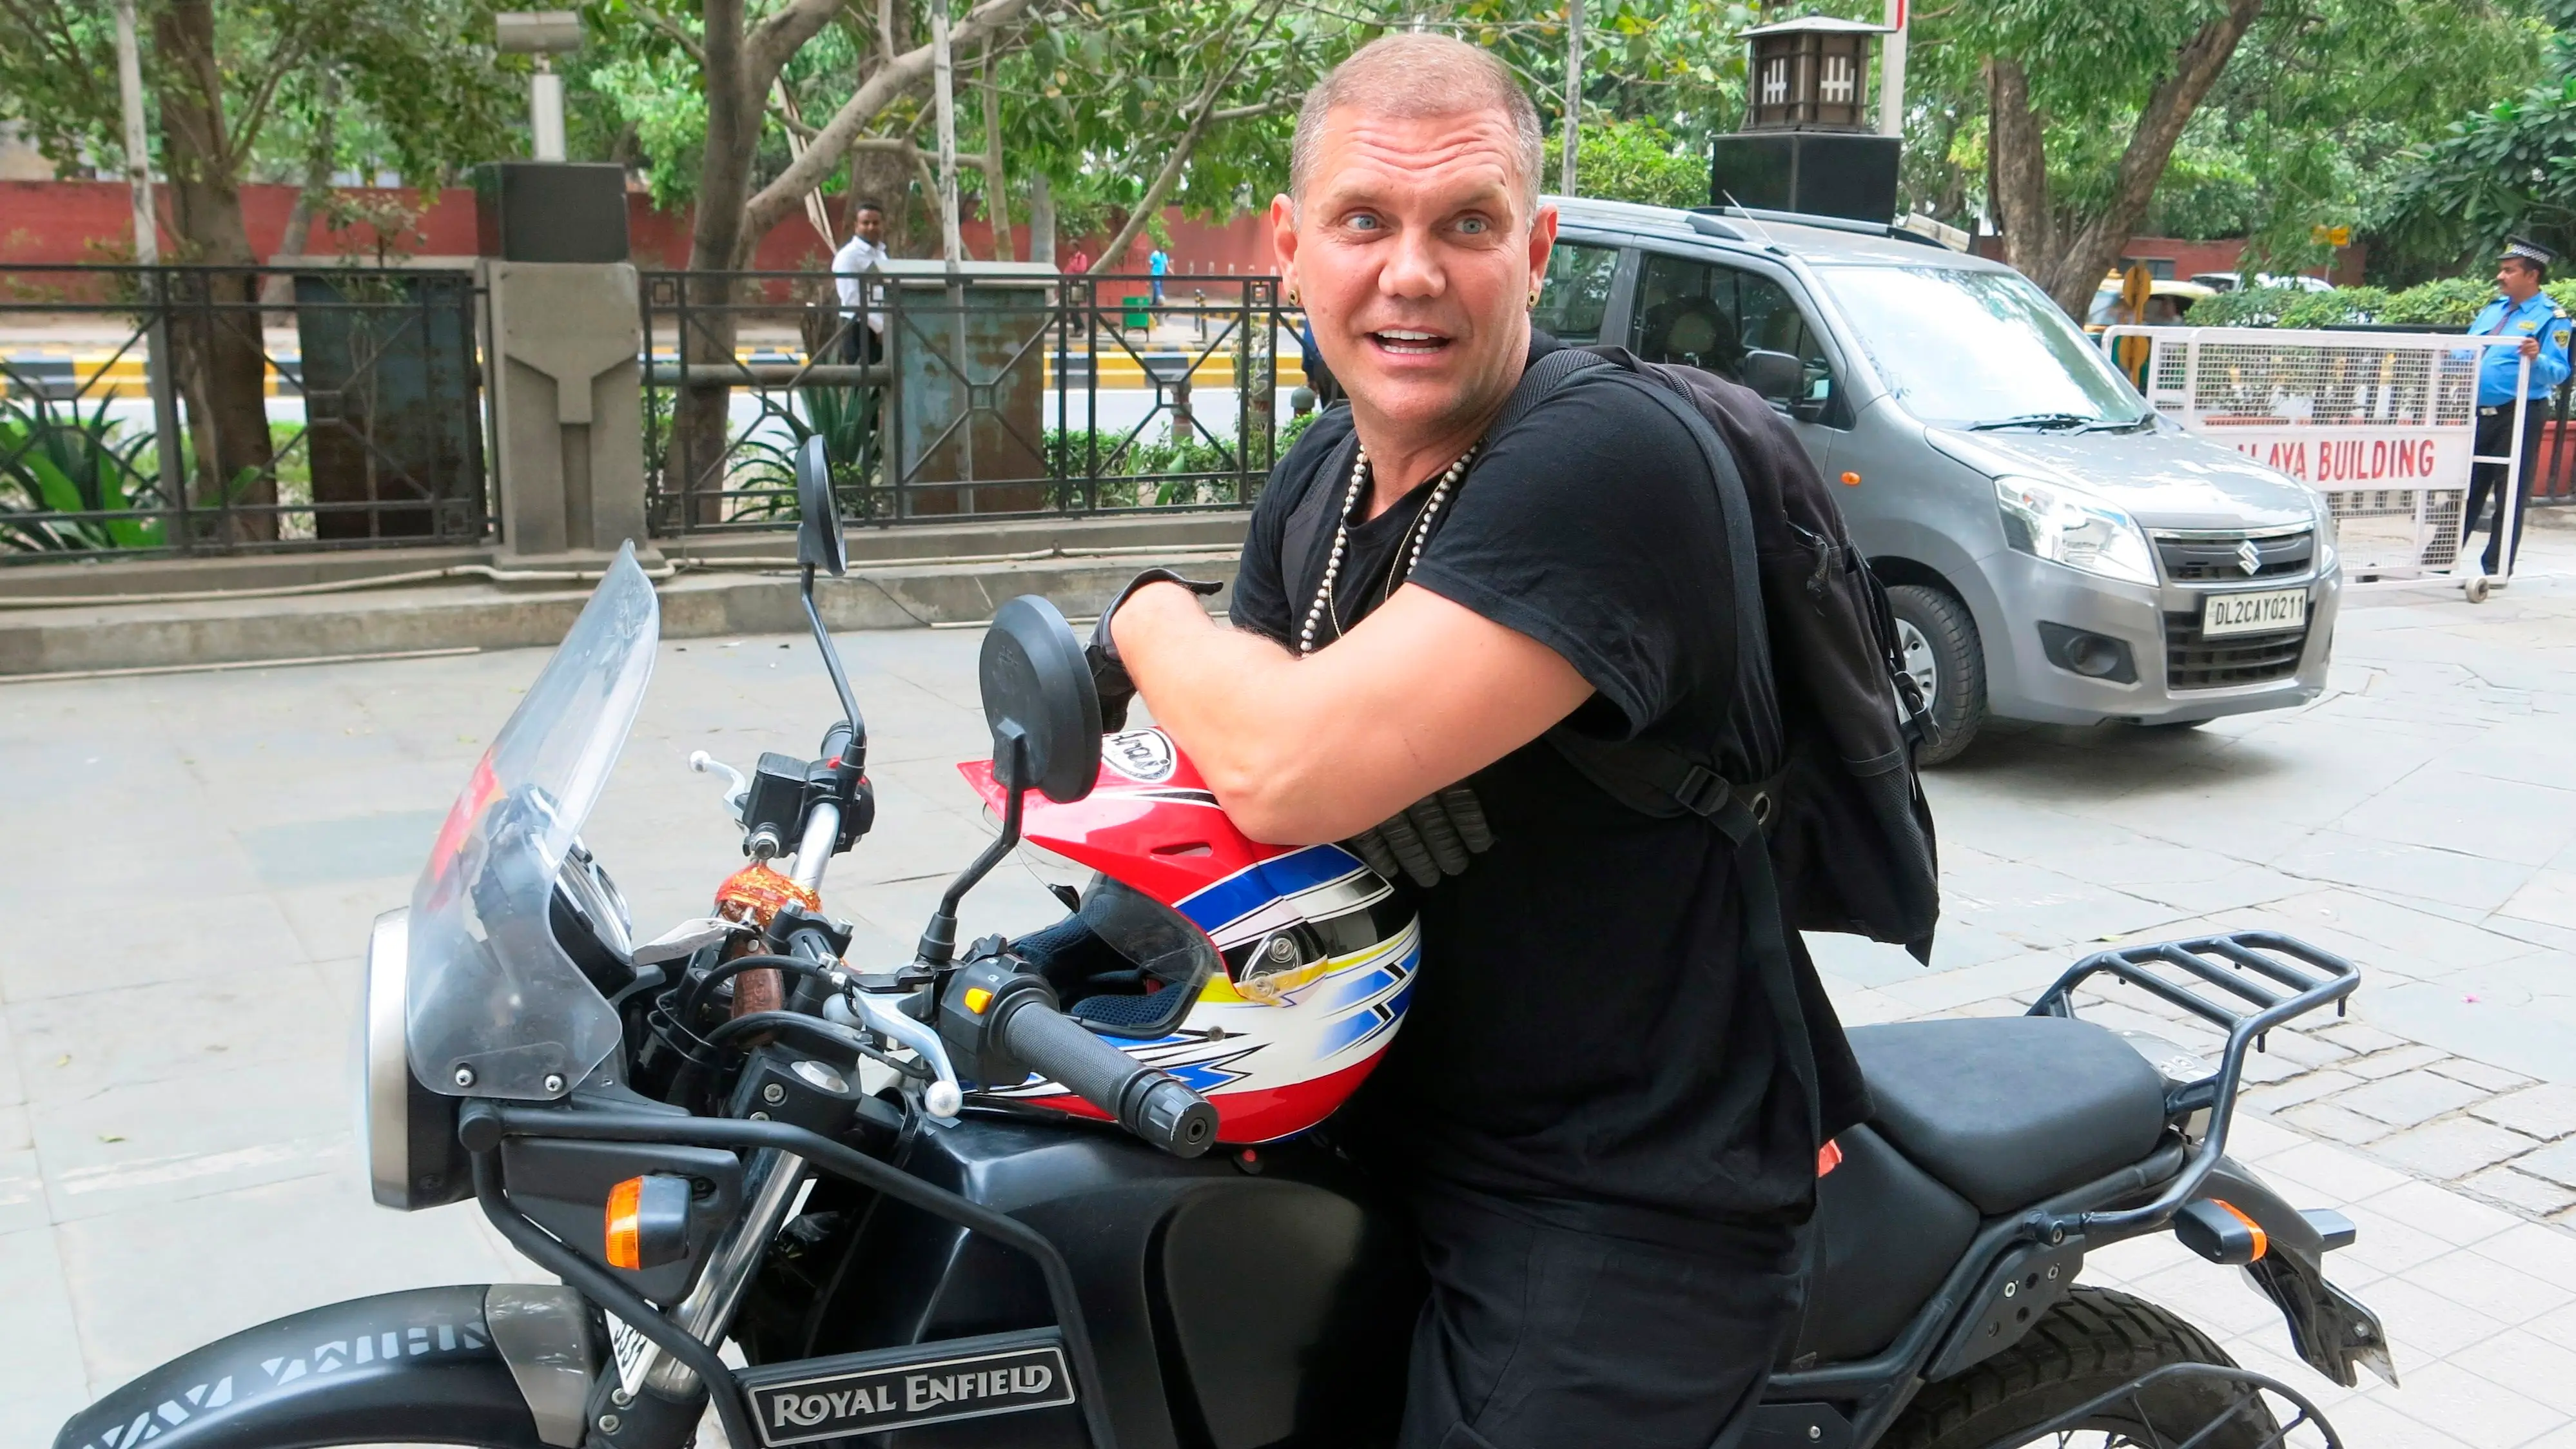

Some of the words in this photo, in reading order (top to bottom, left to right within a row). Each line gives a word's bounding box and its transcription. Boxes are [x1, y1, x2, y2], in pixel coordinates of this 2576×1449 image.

[2317, 440, 2434, 481] BUILDING
[2215, 595, 2304, 625] DL2CAY0211
[772, 1385, 897, 1428] ROYAL
[906, 1365, 1053, 1412] ENFIELD
